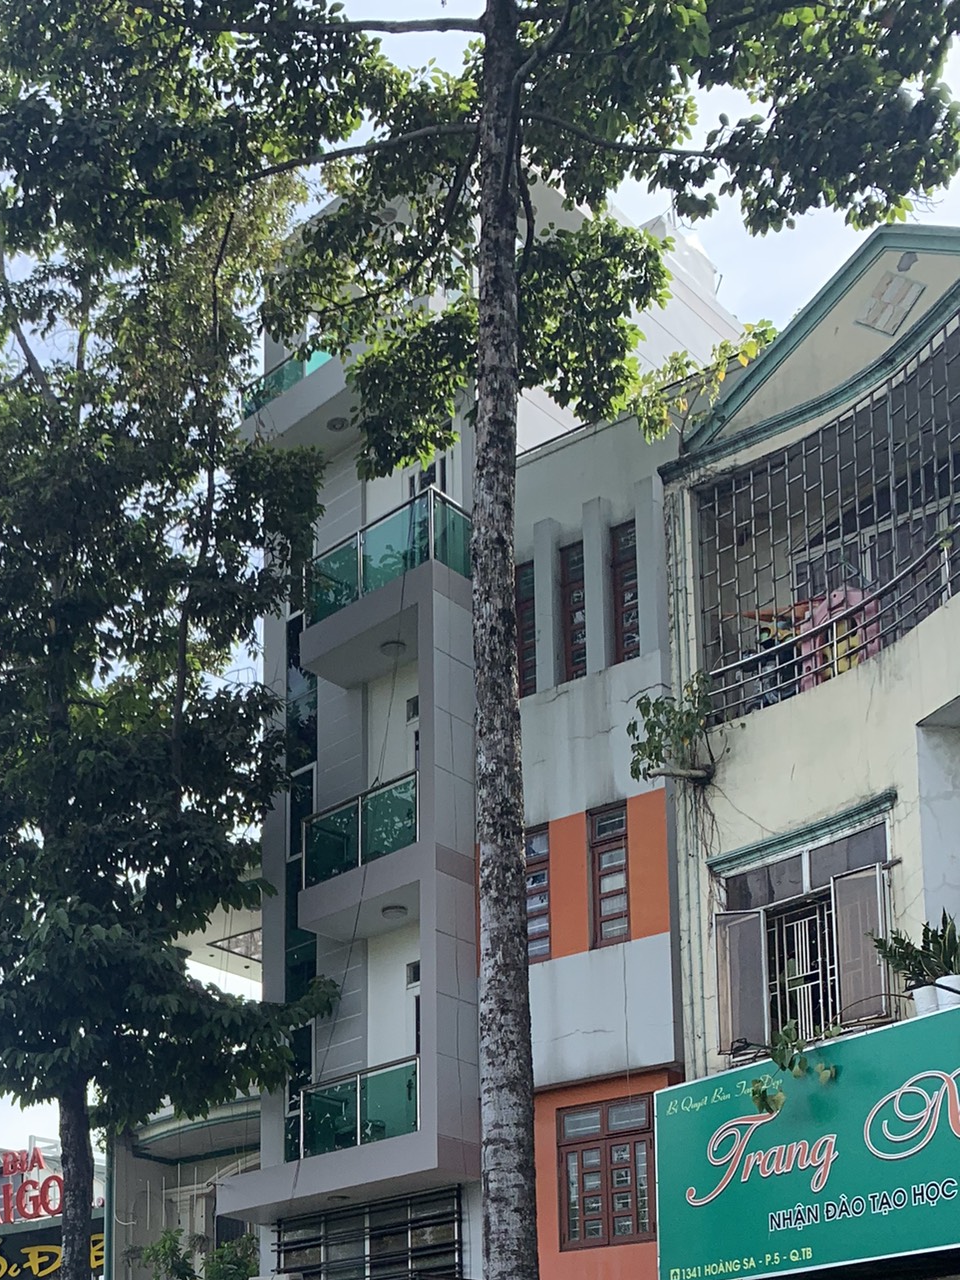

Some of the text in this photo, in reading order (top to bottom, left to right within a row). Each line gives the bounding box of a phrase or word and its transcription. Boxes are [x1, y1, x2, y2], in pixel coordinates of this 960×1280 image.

[3, 1147, 46, 1177] BIA
[686, 1107, 839, 1207] Trang
[769, 1178, 958, 1232] NHẬN ĐÀO TẠO HỌC
[681, 1264, 702, 1280] 1341
[704, 1258, 741, 1277] HOÀNG
[743, 1256, 757, 1270] SA
[765, 1252, 780, 1266] P.5
[790, 1246, 813, 1262] Q.TB
